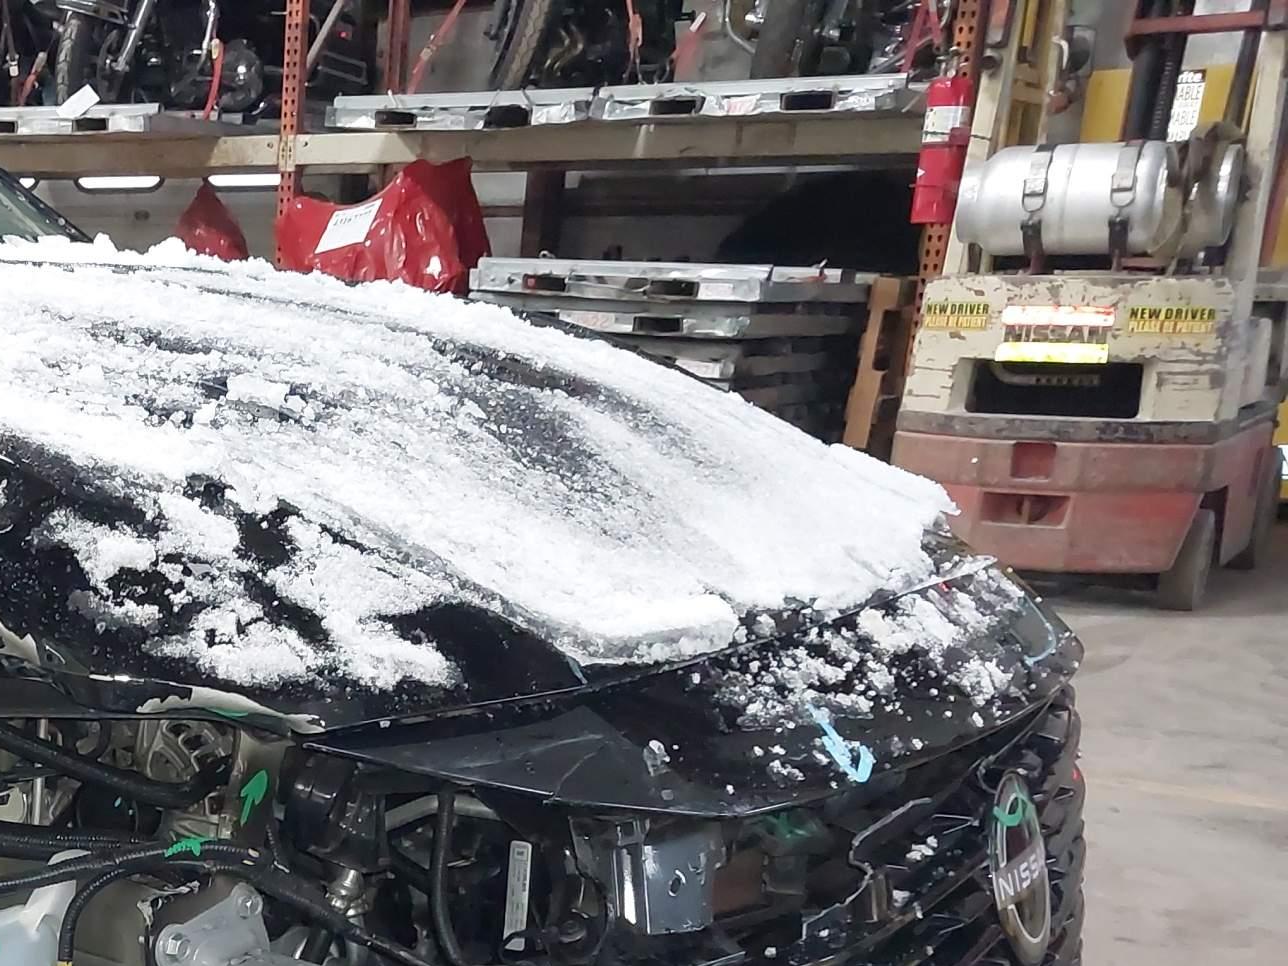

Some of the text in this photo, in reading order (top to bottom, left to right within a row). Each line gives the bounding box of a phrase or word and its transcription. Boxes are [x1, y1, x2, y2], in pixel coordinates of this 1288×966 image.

[926, 303, 990, 315] NEW DRIVER
[1129, 307, 1216, 320] NEW DRIVER
